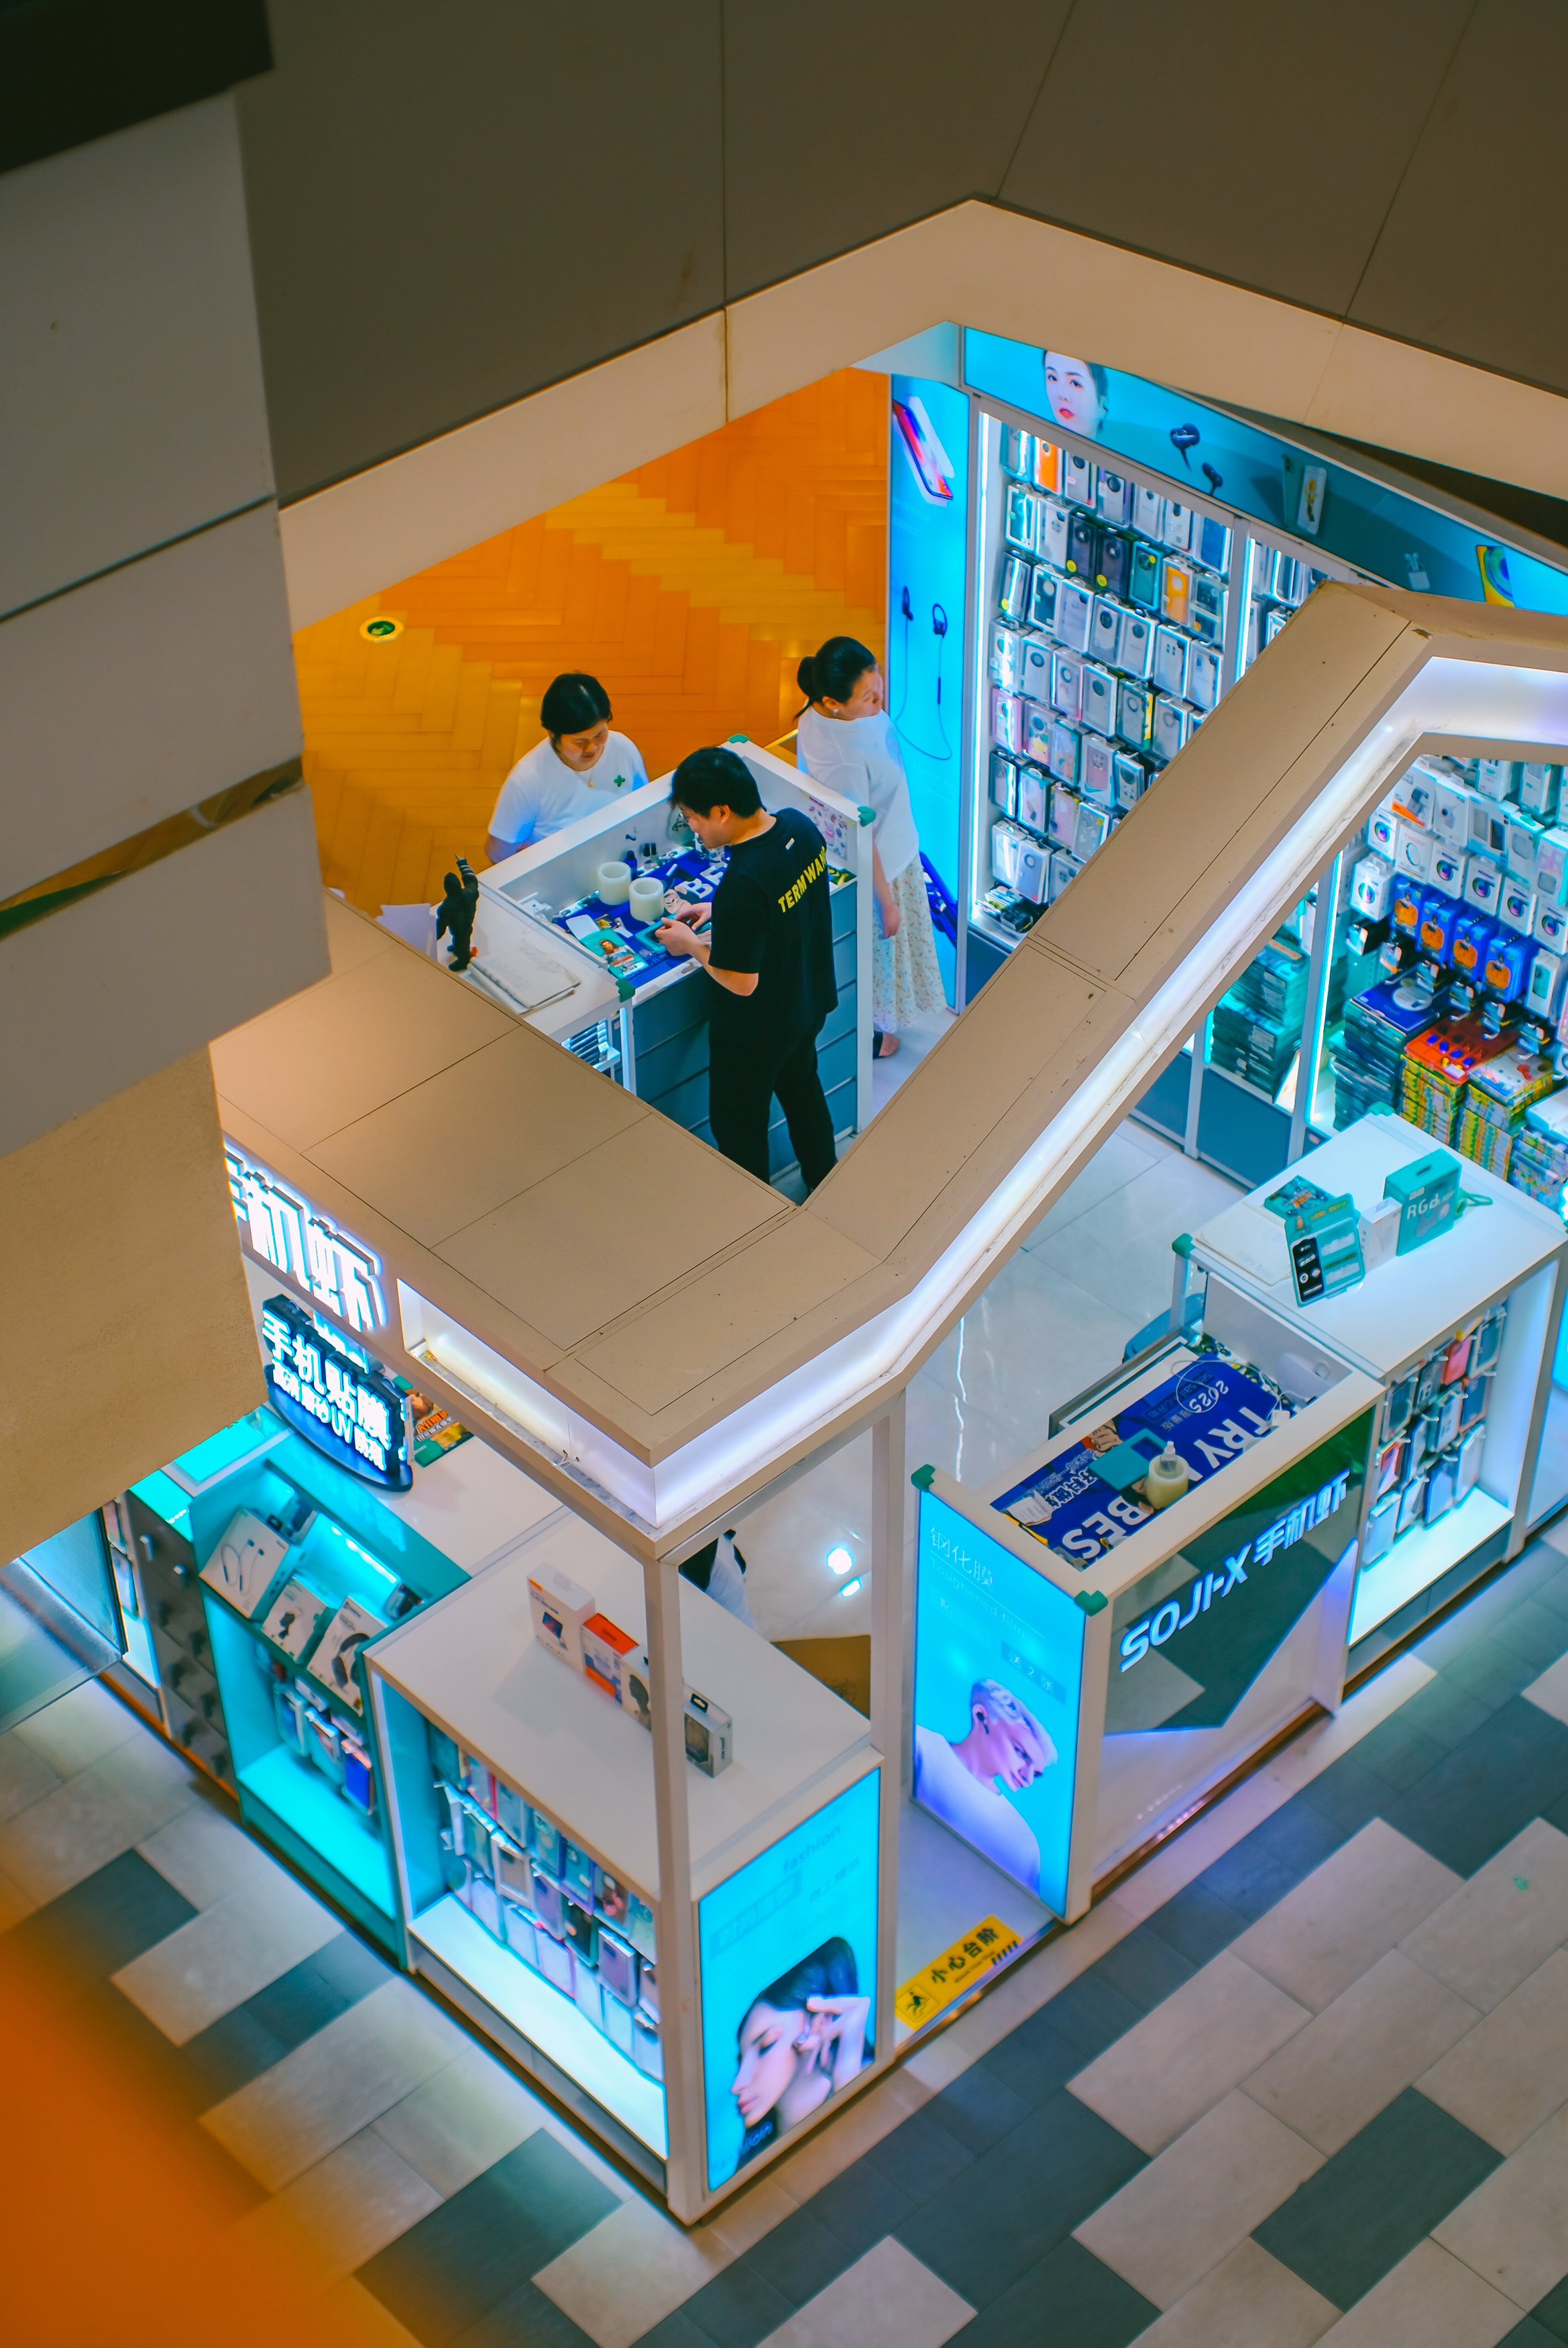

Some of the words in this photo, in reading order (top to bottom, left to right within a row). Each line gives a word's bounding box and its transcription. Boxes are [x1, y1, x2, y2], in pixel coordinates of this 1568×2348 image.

[778, 874, 807, 913] TERM
[224, 1154, 377, 1332] 机虾
[331, 1405, 353, 1443] UV
[1194, 1407, 1269, 1469] TRY
[930, 1526, 994, 1593] 钢化膜
[1062, 1495, 1149, 1561] BES
[930, 1556, 997, 1617] Toughened
[1002, 1613, 1025, 1638] film
[1119, 1542, 1252, 1673] SOJI-X
[1252, 1469, 1350, 1566] 手机虾
[784, 1825, 840, 1874] fashion
[932, 1927, 999, 1984] 小心台阶
